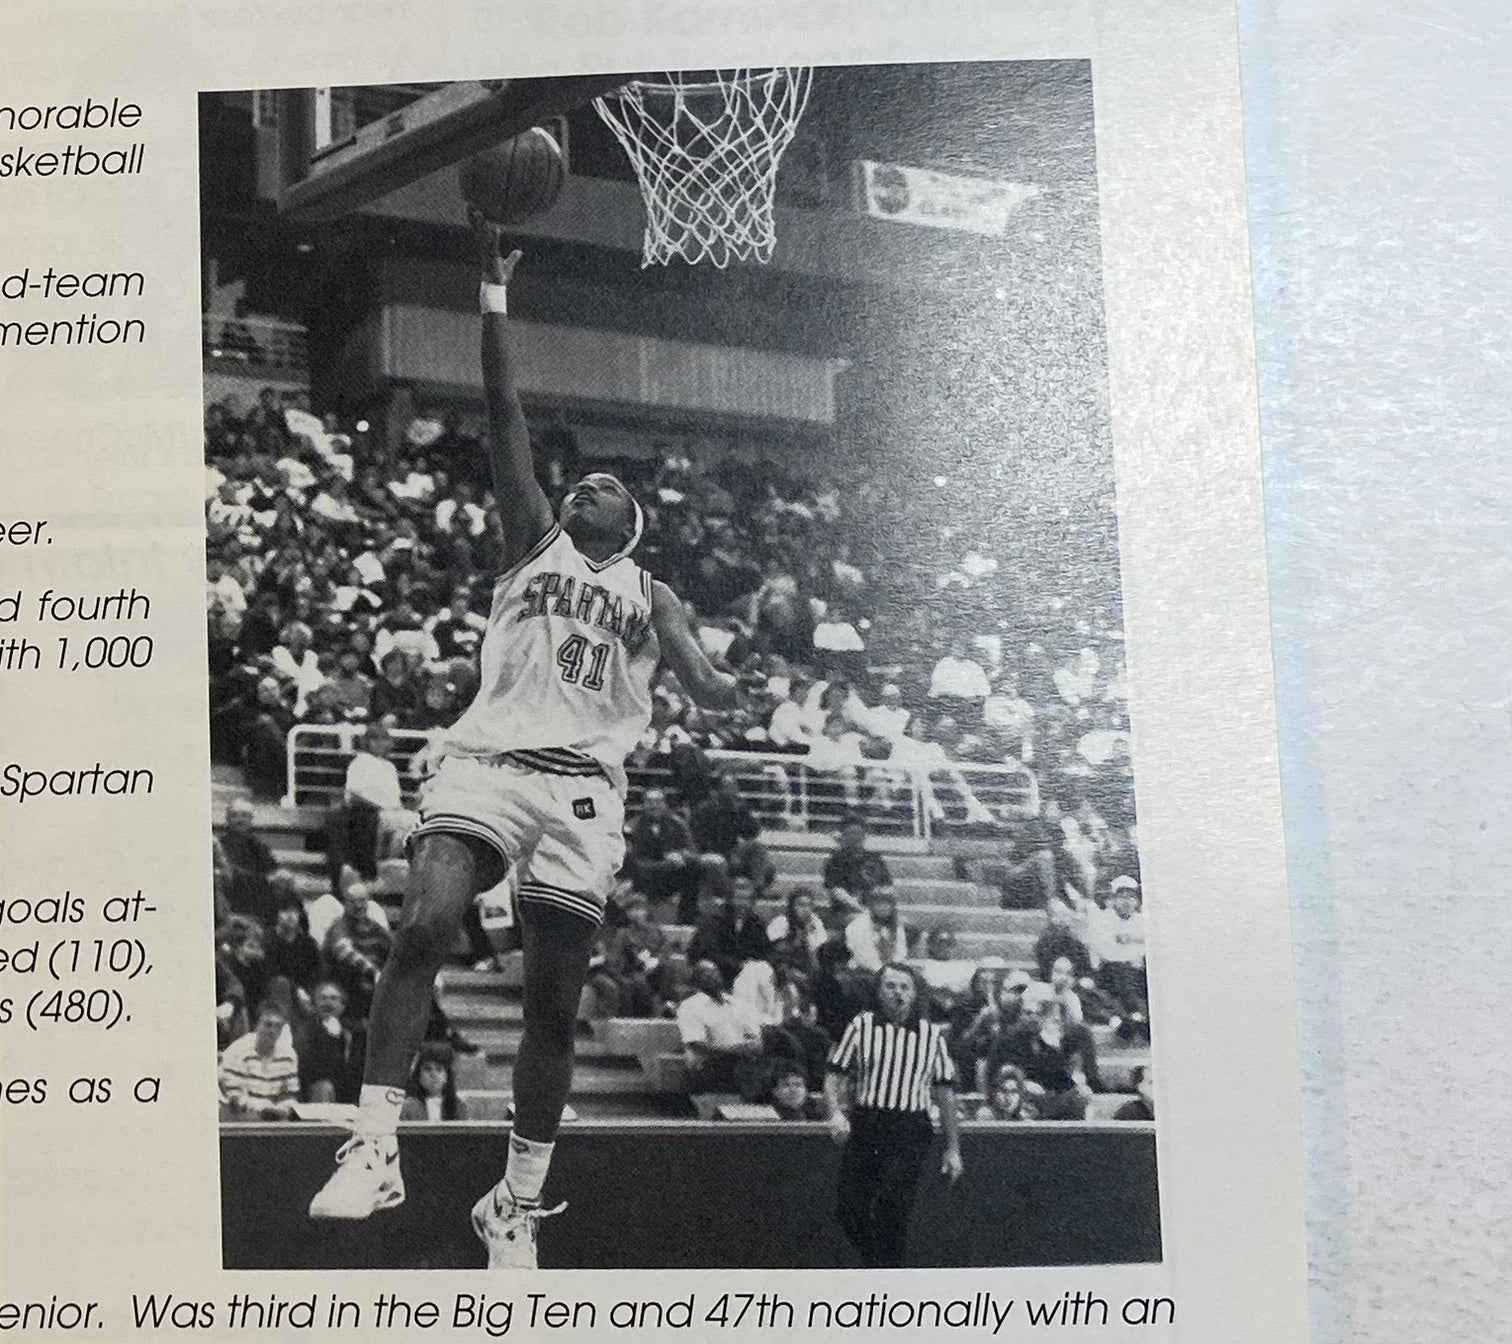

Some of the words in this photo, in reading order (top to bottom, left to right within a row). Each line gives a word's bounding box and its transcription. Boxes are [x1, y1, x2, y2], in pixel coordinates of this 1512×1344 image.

[39, 589, 150, 621] fourth
[556, 633, 610, 691] 41
[0, 763, 153, 803] Spartan
